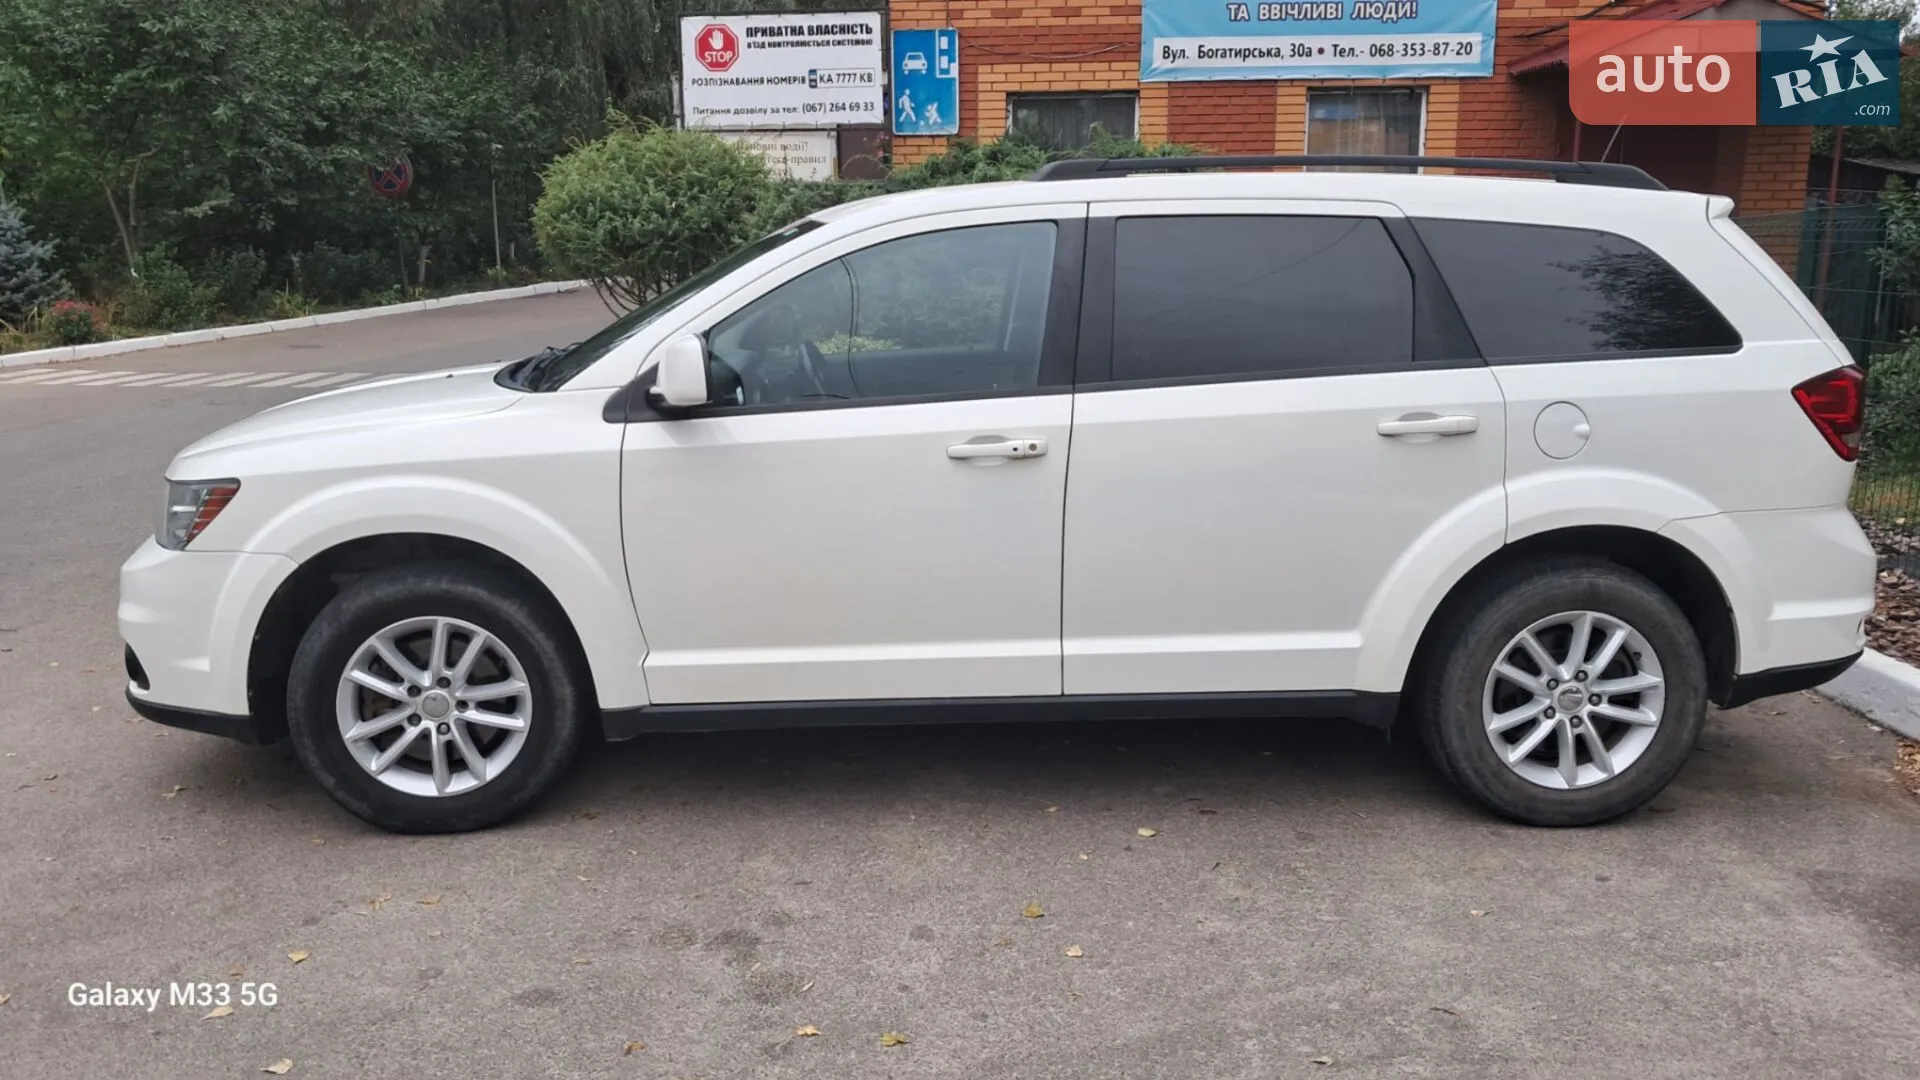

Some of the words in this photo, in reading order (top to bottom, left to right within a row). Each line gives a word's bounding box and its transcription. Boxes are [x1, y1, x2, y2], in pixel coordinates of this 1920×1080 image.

[1227, 3, 1250, 21] ТА
[1258, 1, 1344, 21] ВВІЧЛИВІ
[1351, 0, 1418, 23] ЛЮДИ!
[746, 25, 805, 38] ПРИВАТНА
[807, 23, 873, 36] ВЛАСНІСТЬ
[832, 38, 873, 46] СИСТЕМОЮ
[704, 51, 733, 63] STOP
[1162, 45, 1189, 63] Вул.
[1198, 44, 1284, 62] Богатирська,
[1289, 43, 1312, 58] 30а
[1369, 42, 1473, 58] 068-353-87-20
[691, 76, 764, 86] РОЗПІЗНАВАННЯ
[767, 75, 806, 85] НОМЕРІВ
[836, 73, 857, 83] 7777
[693, 106, 731, 115] Питання
[802, 102, 827, 114] (067)
[829, 102, 846, 112] 264
[849, 102, 861, 112] 69
[863, 101, 875, 111] 33
